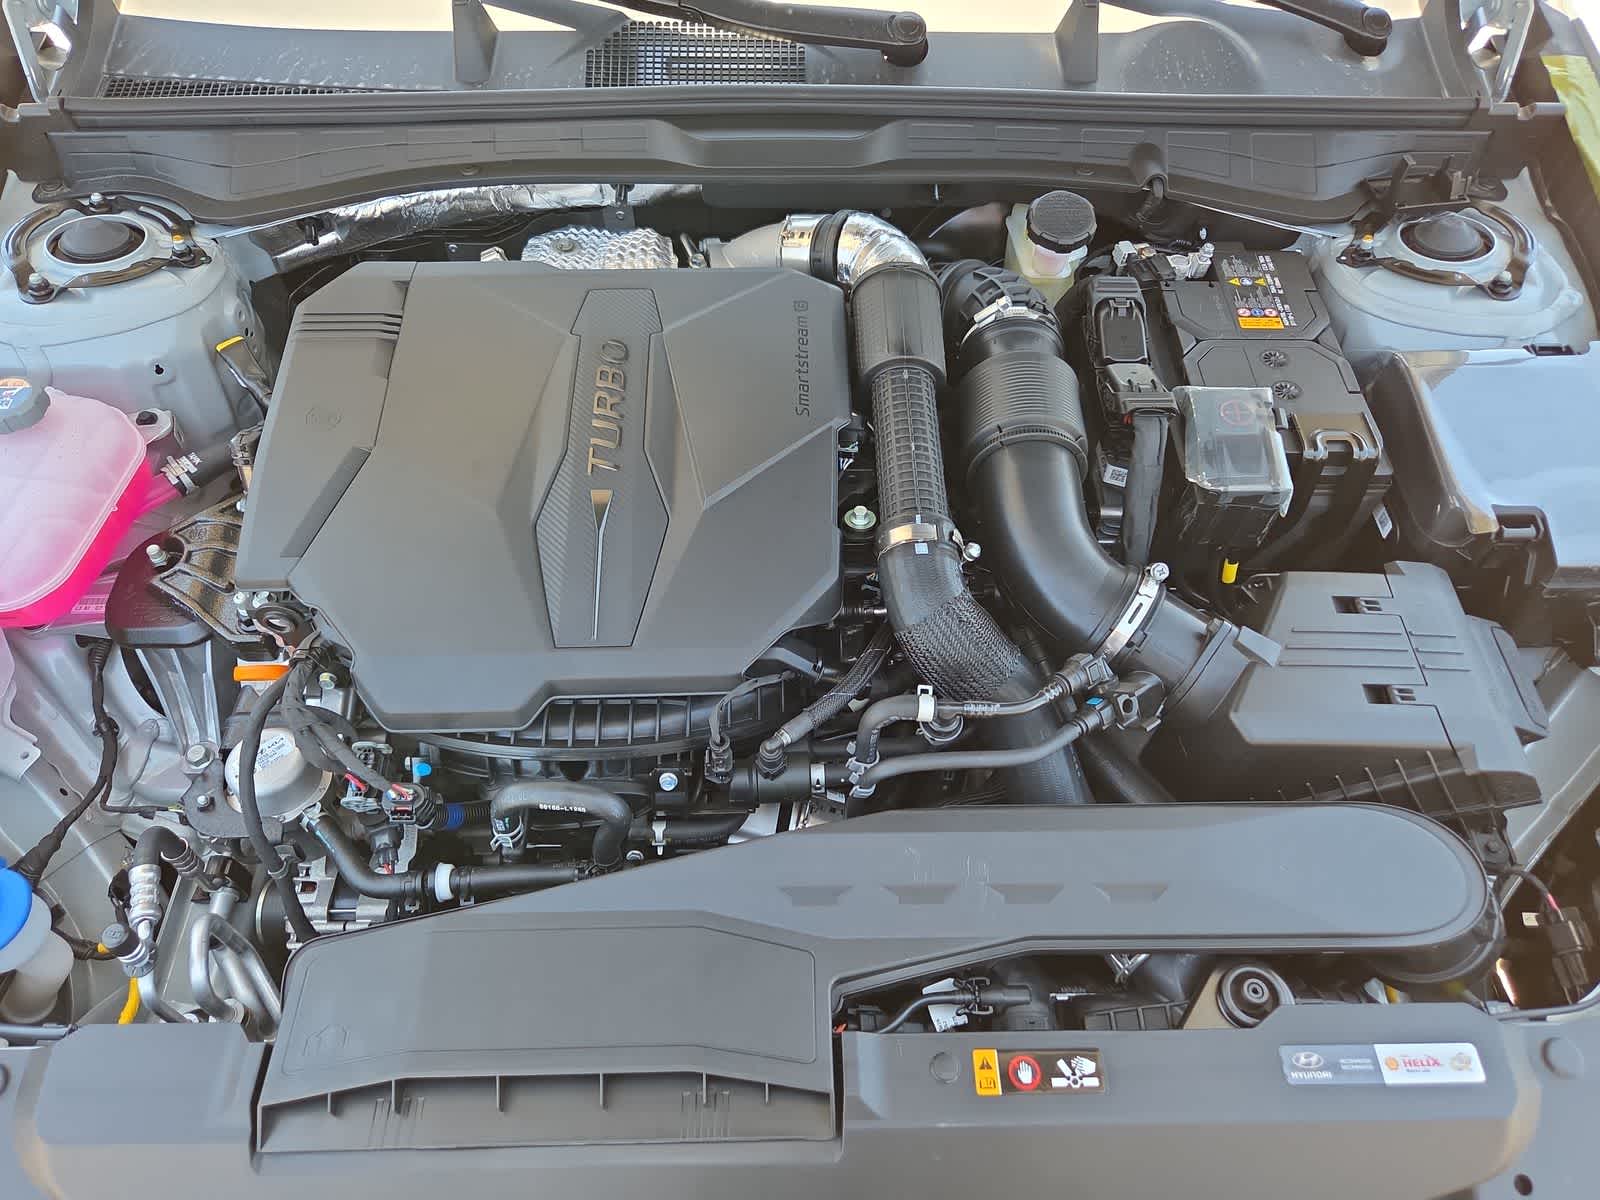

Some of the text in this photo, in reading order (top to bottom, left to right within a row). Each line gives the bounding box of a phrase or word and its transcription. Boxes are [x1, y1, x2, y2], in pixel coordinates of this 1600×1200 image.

[795, 316, 810, 417] Smartstream
[588, 340, 629, 476] TURBO
[1290, 1070, 1333, 1080] HYUNDAI
[1402, 1055, 1441, 1067] HELIX
